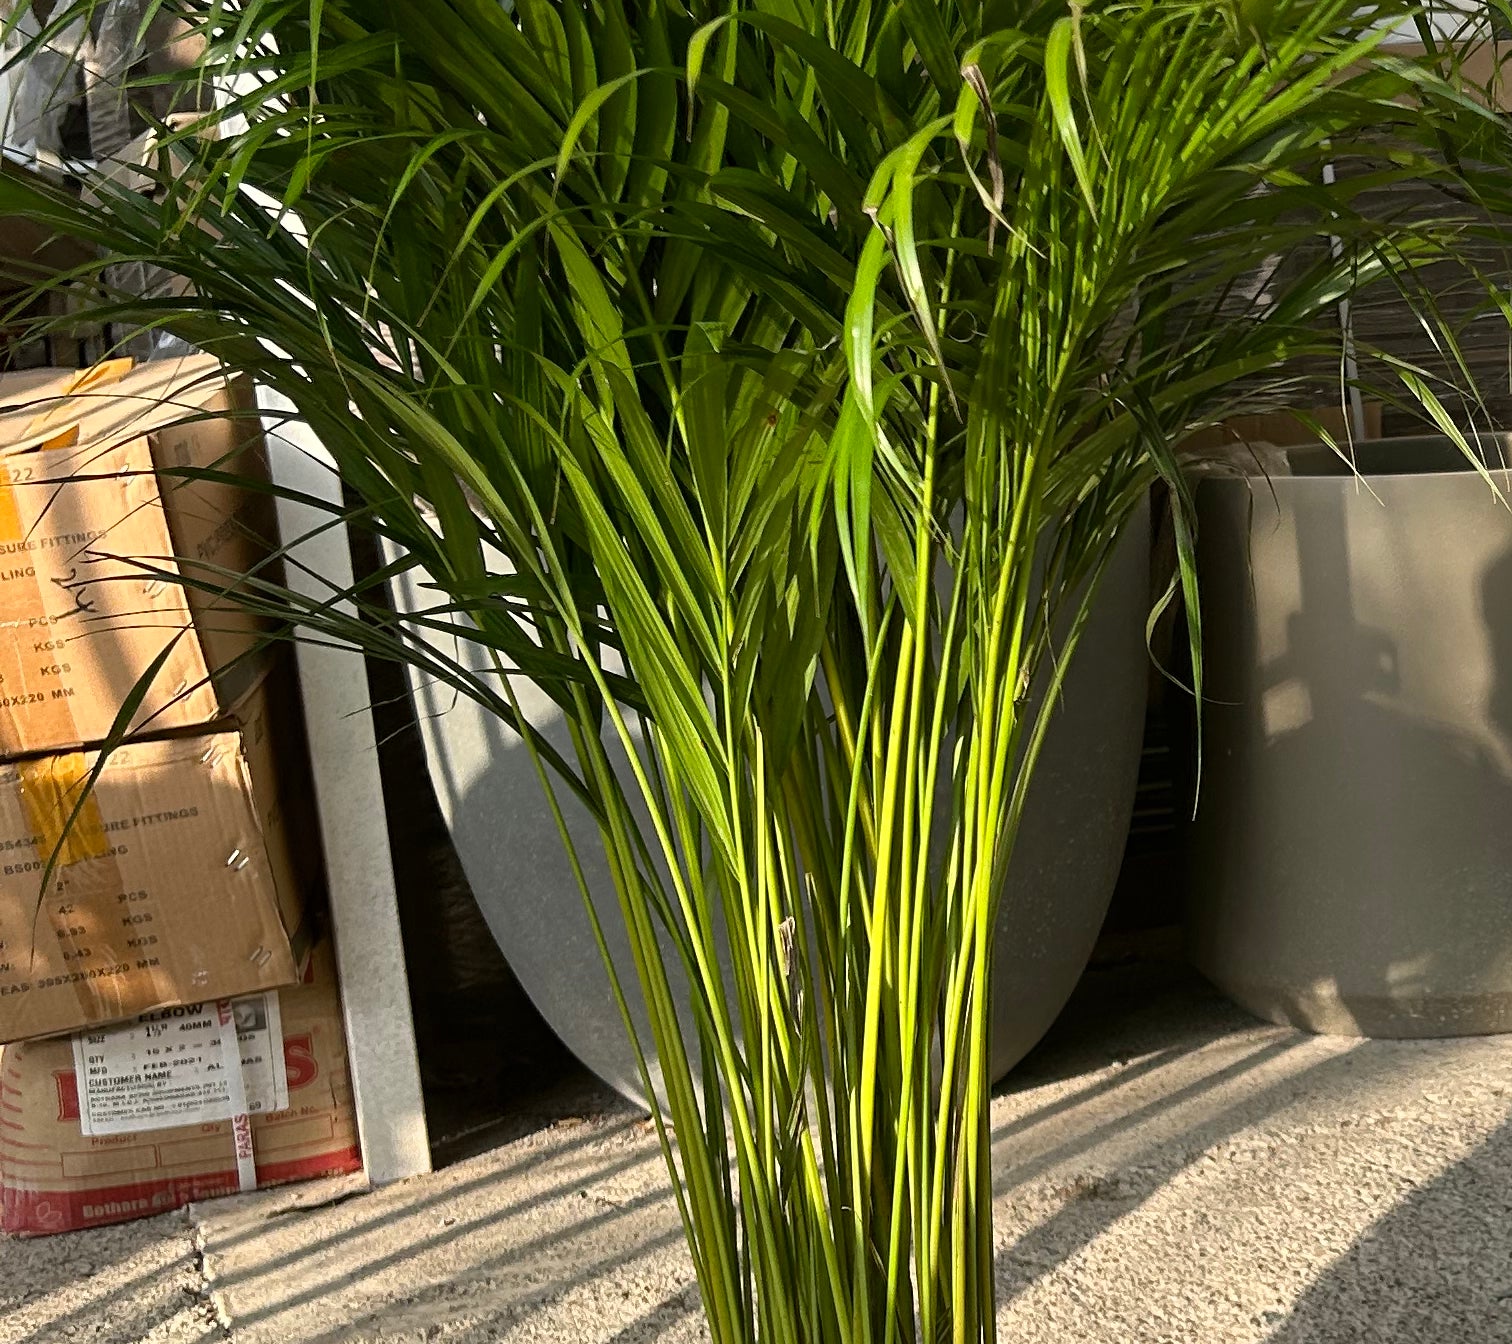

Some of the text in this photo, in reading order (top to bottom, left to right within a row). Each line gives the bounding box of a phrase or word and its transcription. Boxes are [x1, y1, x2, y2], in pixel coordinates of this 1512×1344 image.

[40, 662, 72, 676] KGS
[51, 687, 75, 699] MM
[133, 806, 199, 827] FITTINGS
[117, 890, 148, 903] PCS
[122, 913, 153, 927] KGS
[137, 957, 160, 969] MM
[88, 1074, 142, 1087] CUSTOMER
